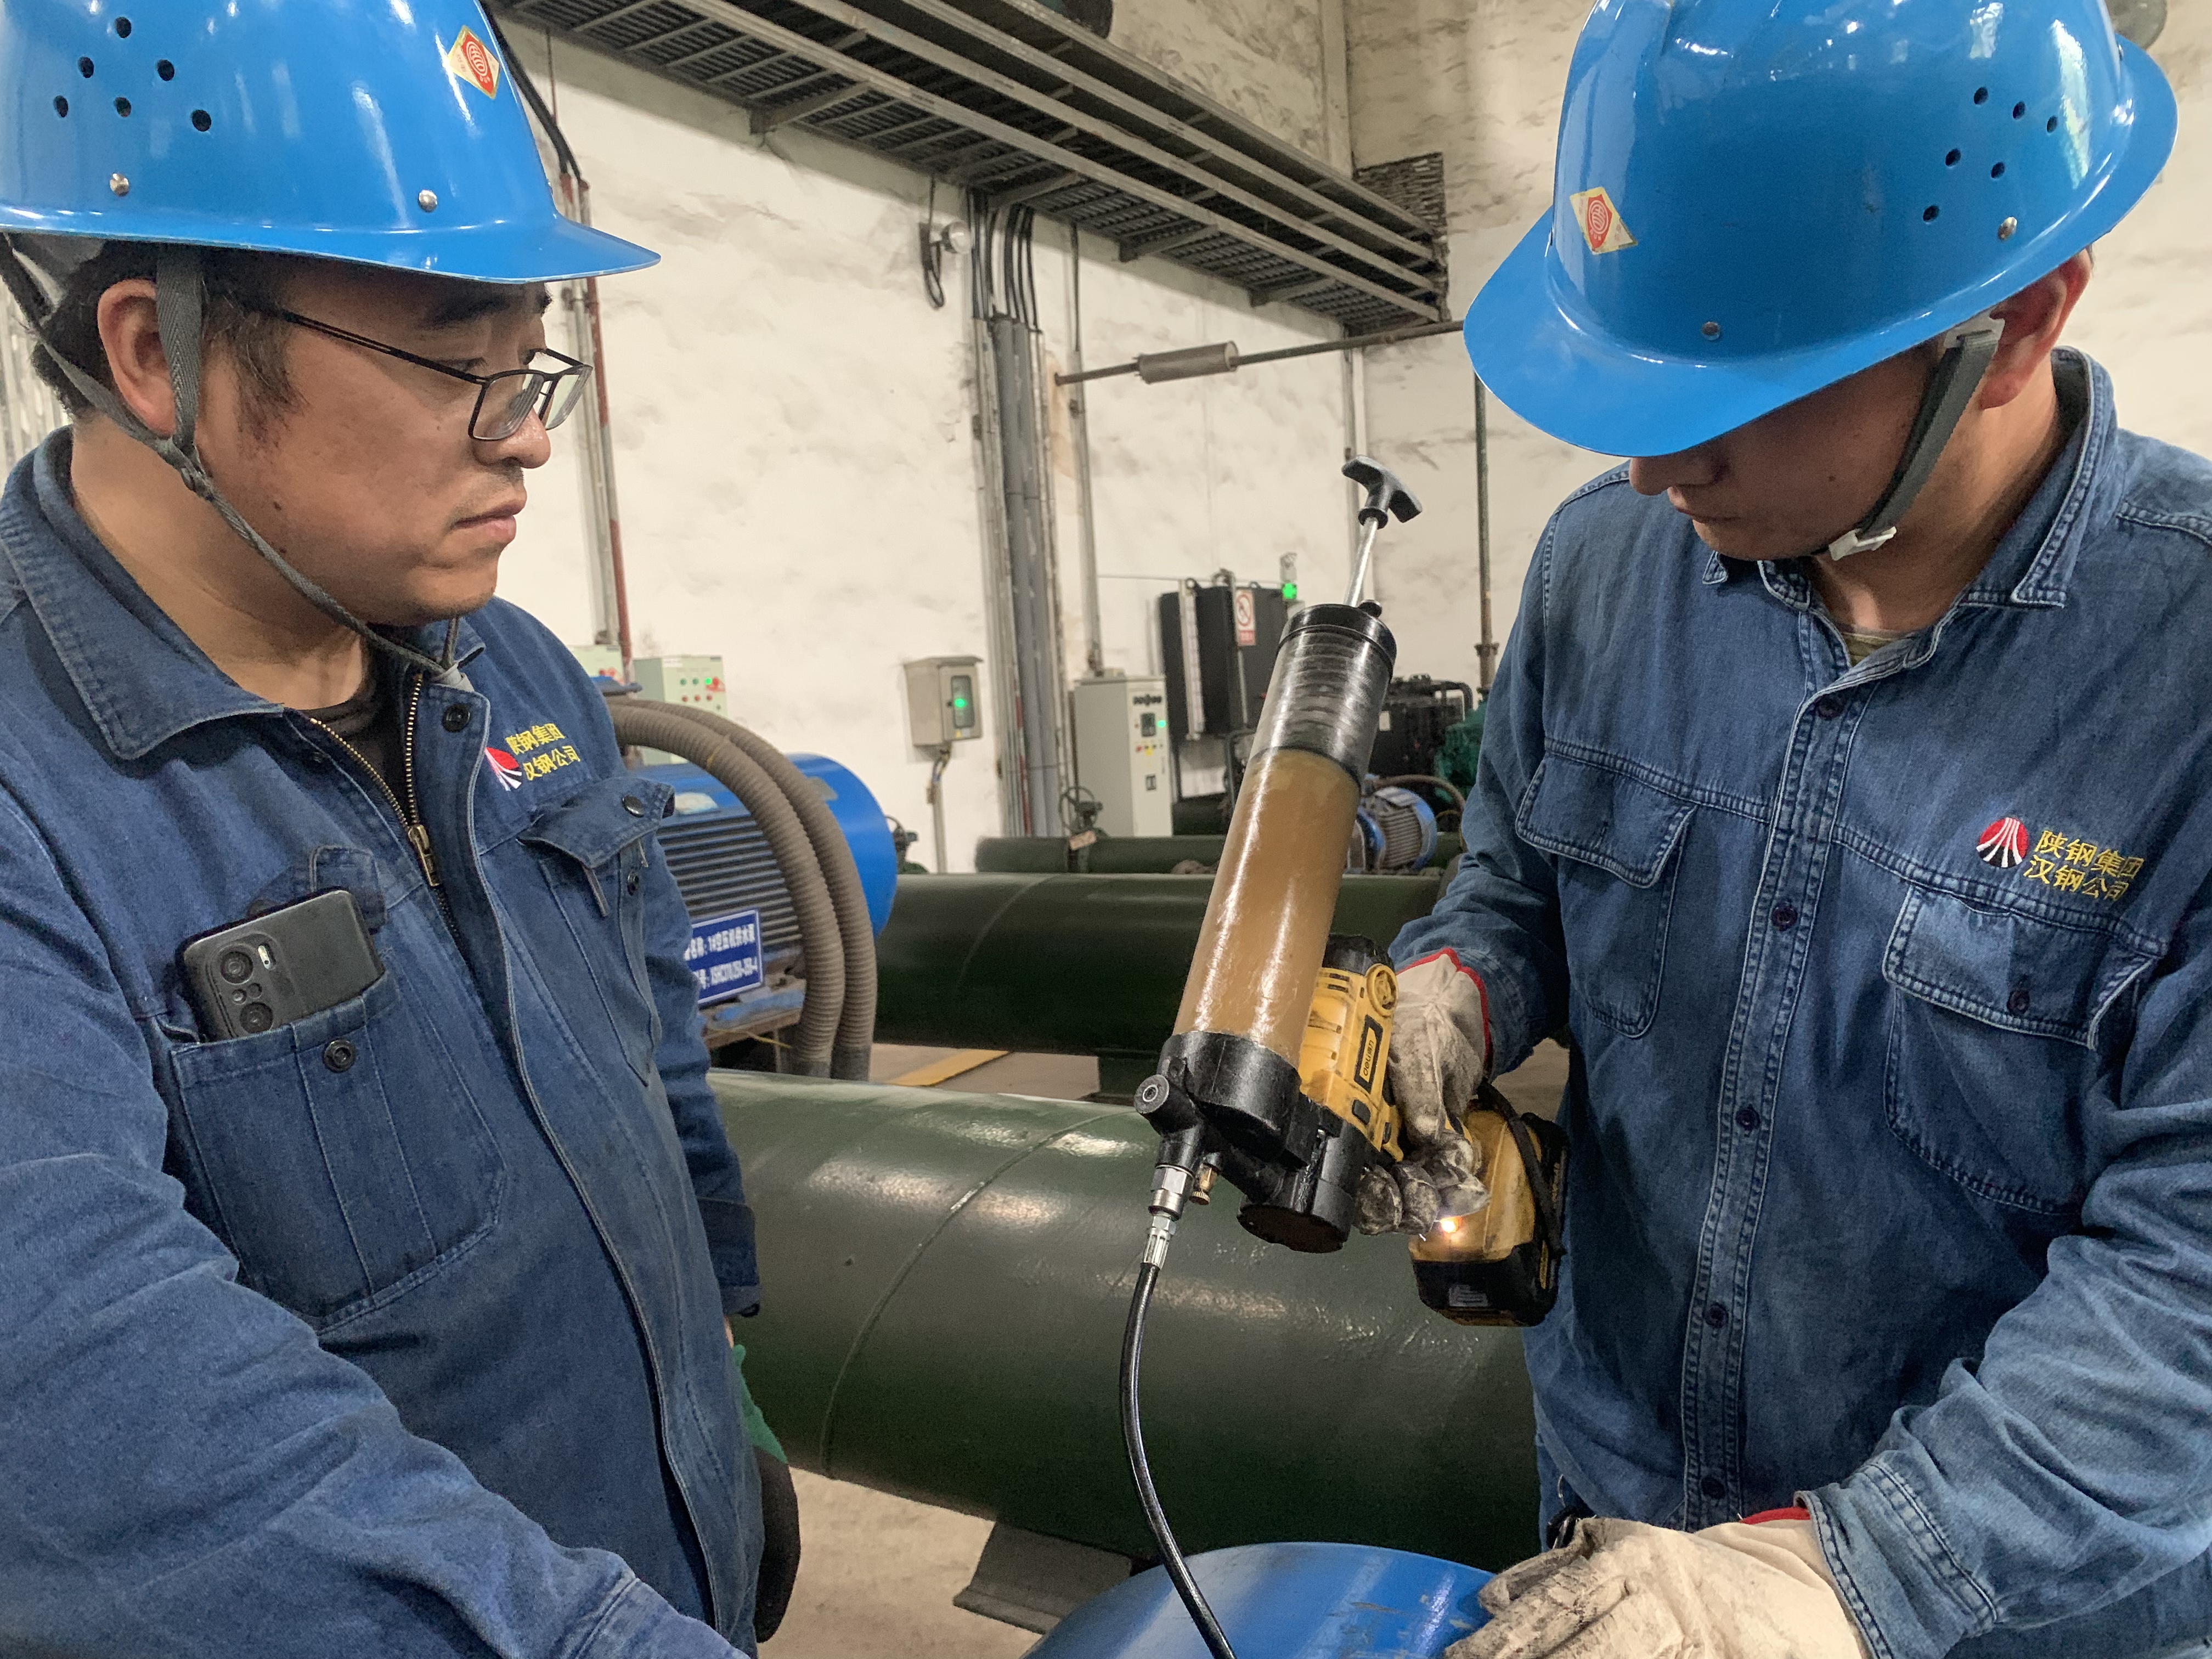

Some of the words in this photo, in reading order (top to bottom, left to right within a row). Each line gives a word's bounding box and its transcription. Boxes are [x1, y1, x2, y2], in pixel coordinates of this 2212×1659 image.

[505, 723, 566, 755] 陕钢集团
[2035, 830, 2145, 879] 陕钢集团
[2023, 855, 2129, 901] 汉钢公司
